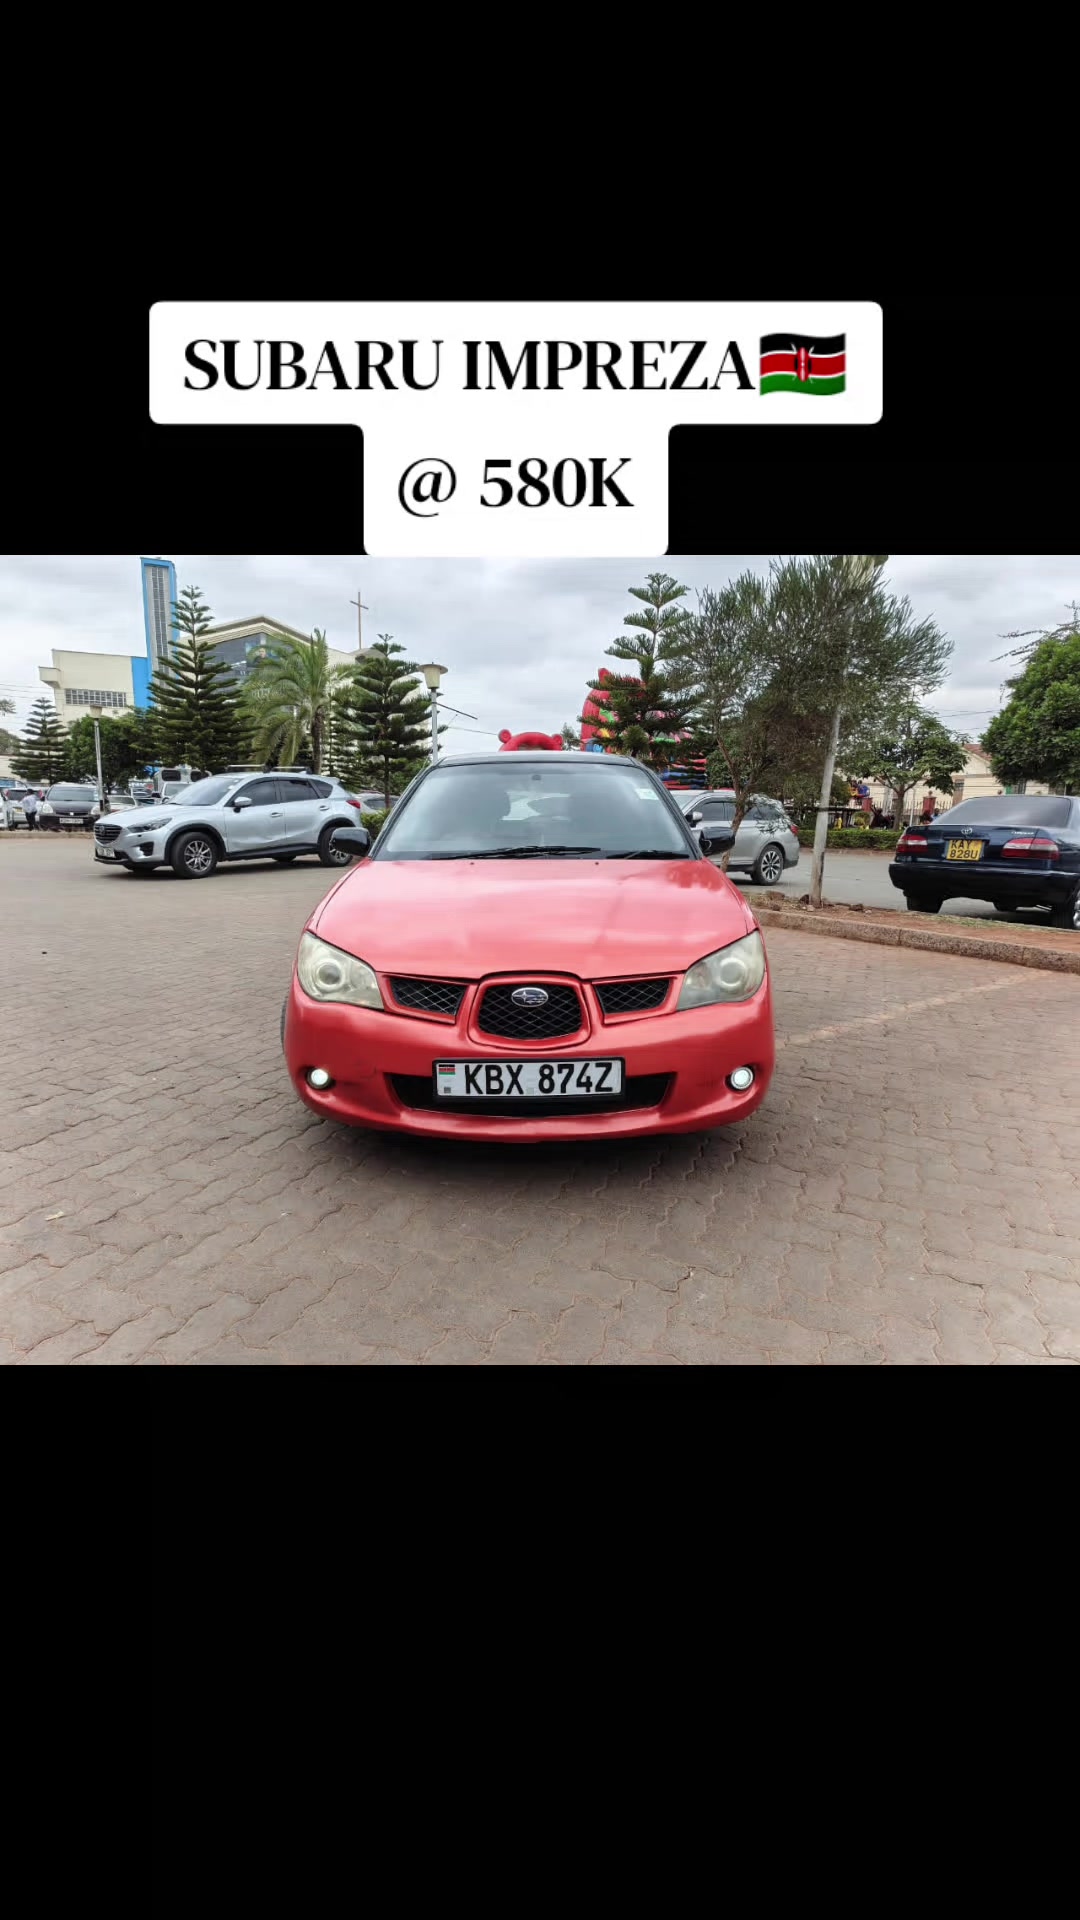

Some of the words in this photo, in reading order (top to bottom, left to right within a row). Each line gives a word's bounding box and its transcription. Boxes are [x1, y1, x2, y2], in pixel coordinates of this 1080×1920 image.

[950, 839, 972, 849] KAY
[949, 849, 978, 859] 828U
[464, 1064, 524, 1095] KBX
[538, 1062, 613, 1094] 874Z
